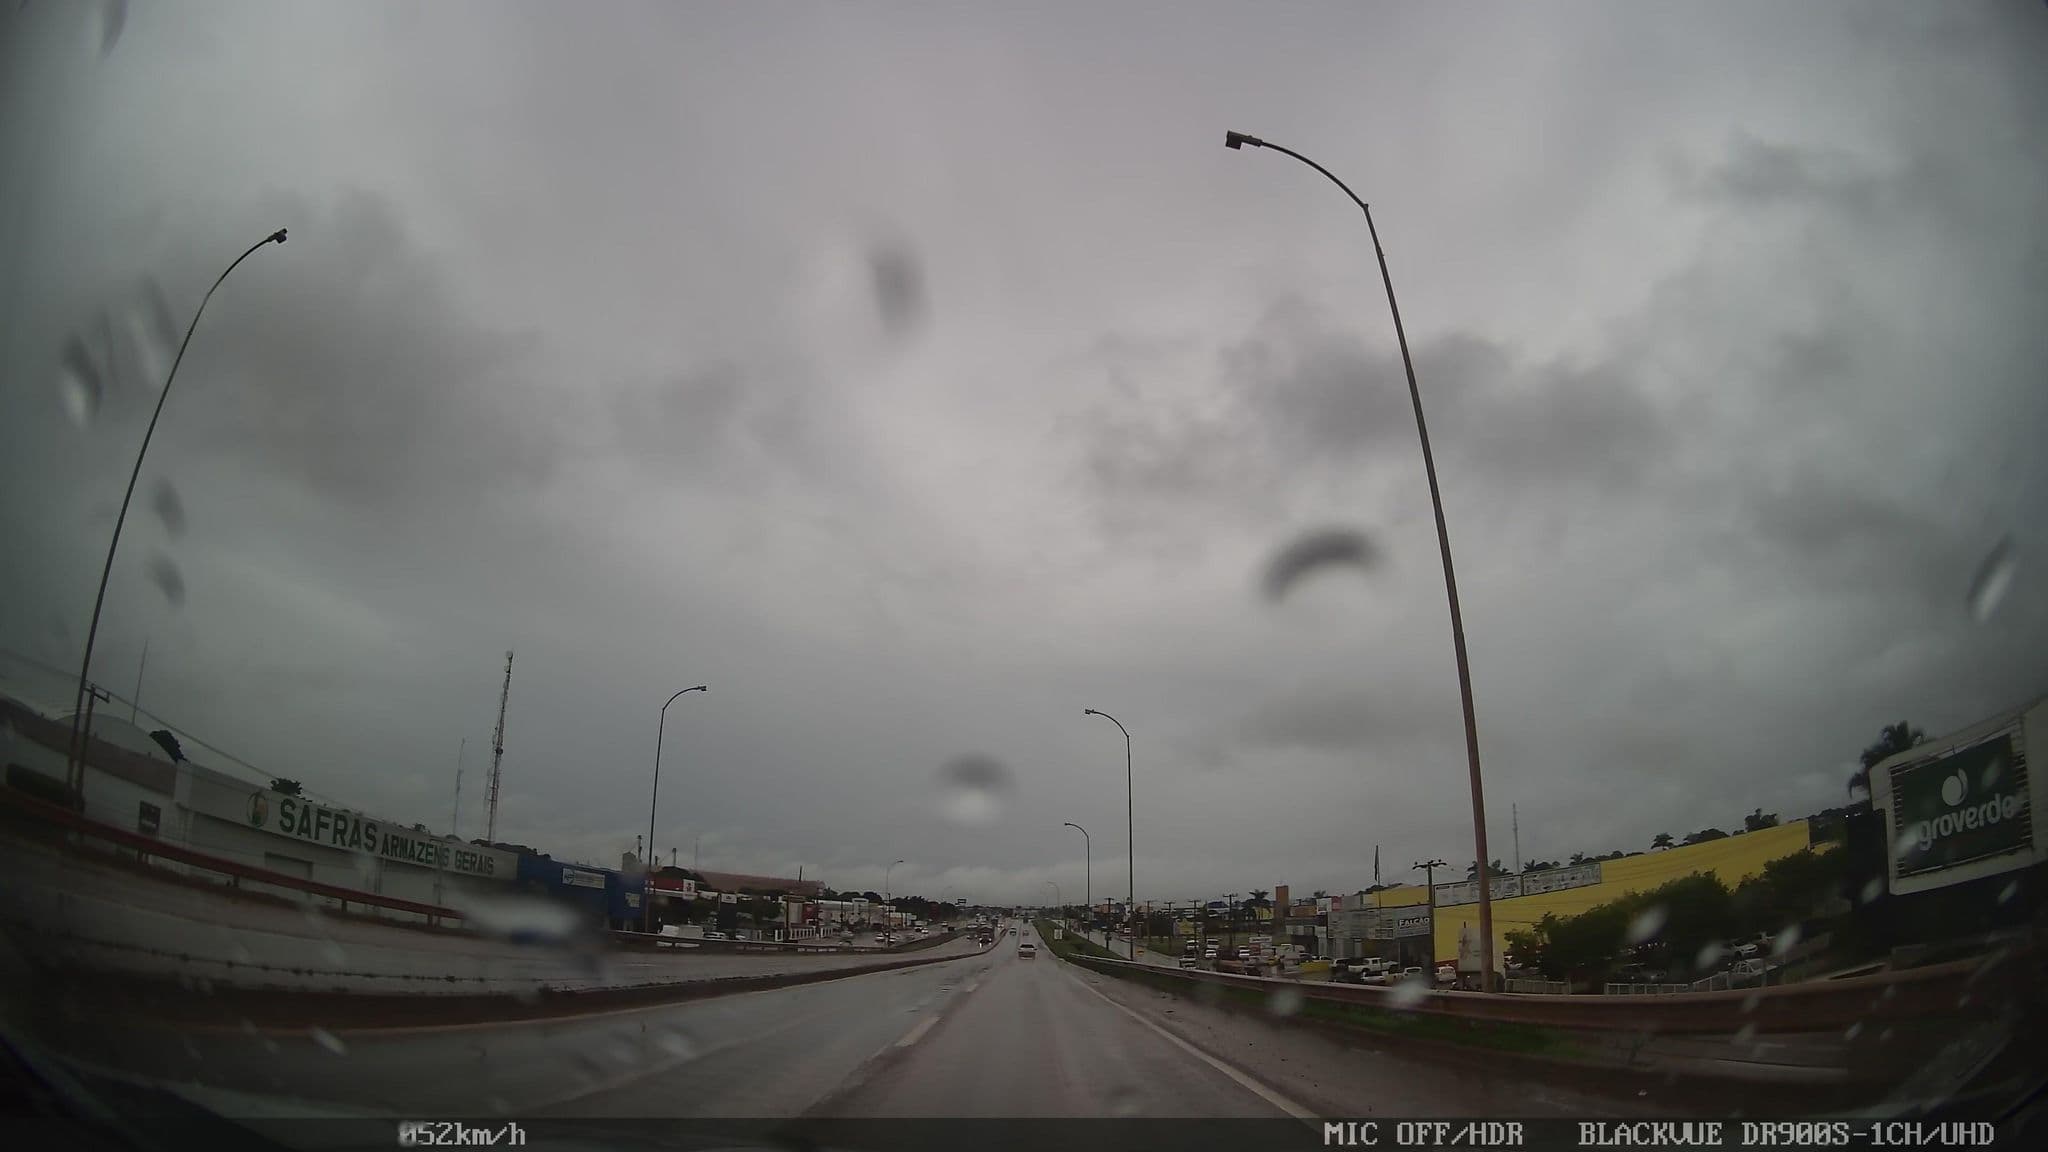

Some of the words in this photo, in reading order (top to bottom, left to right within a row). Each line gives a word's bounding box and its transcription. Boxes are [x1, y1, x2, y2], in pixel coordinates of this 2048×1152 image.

[279, 798, 377, 852] SAFRAS
[381, 833, 449, 867] ARMAZENS
[454, 849, 494, 875] GERAIS
[1904, 793, 2016, 851] groverde
